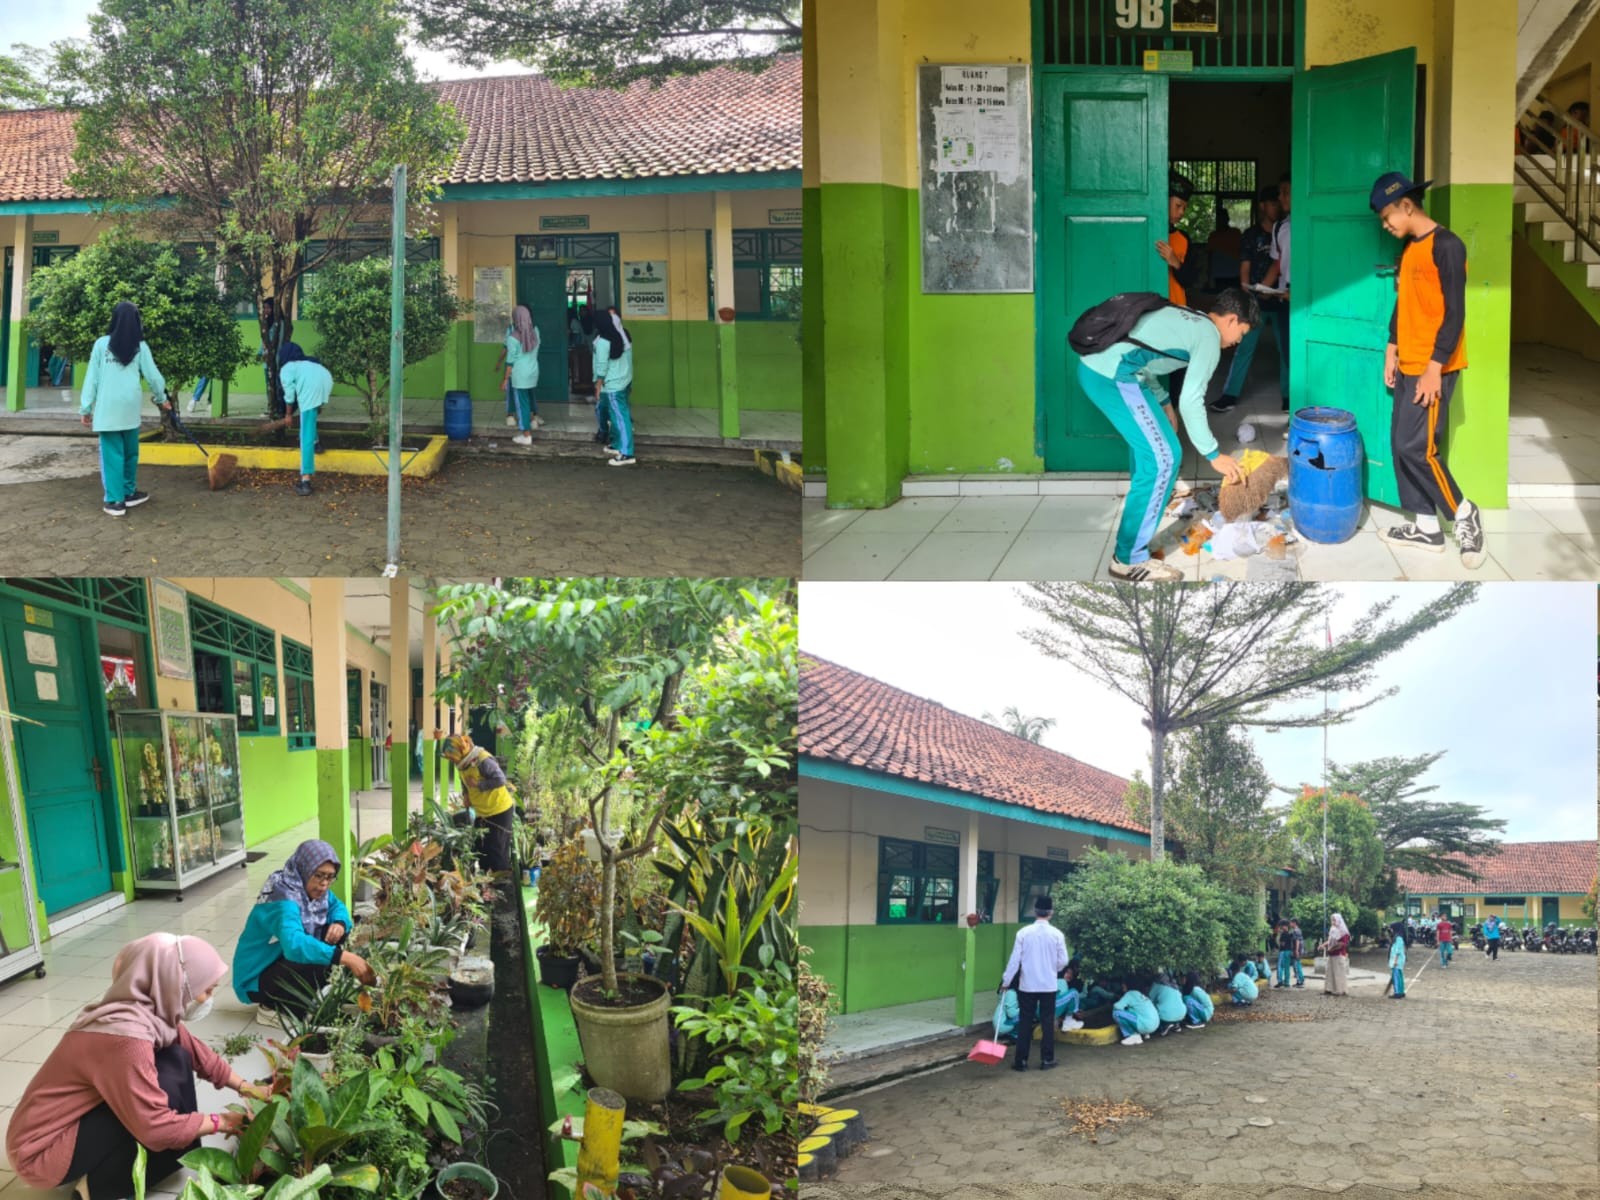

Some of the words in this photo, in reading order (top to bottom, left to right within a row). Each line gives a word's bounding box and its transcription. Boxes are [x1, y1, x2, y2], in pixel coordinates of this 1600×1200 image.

[1115, 0, 1164, 29] 9B
[520, 245, 536, 259] 7C
[627, 295, 665, 304] POHON
